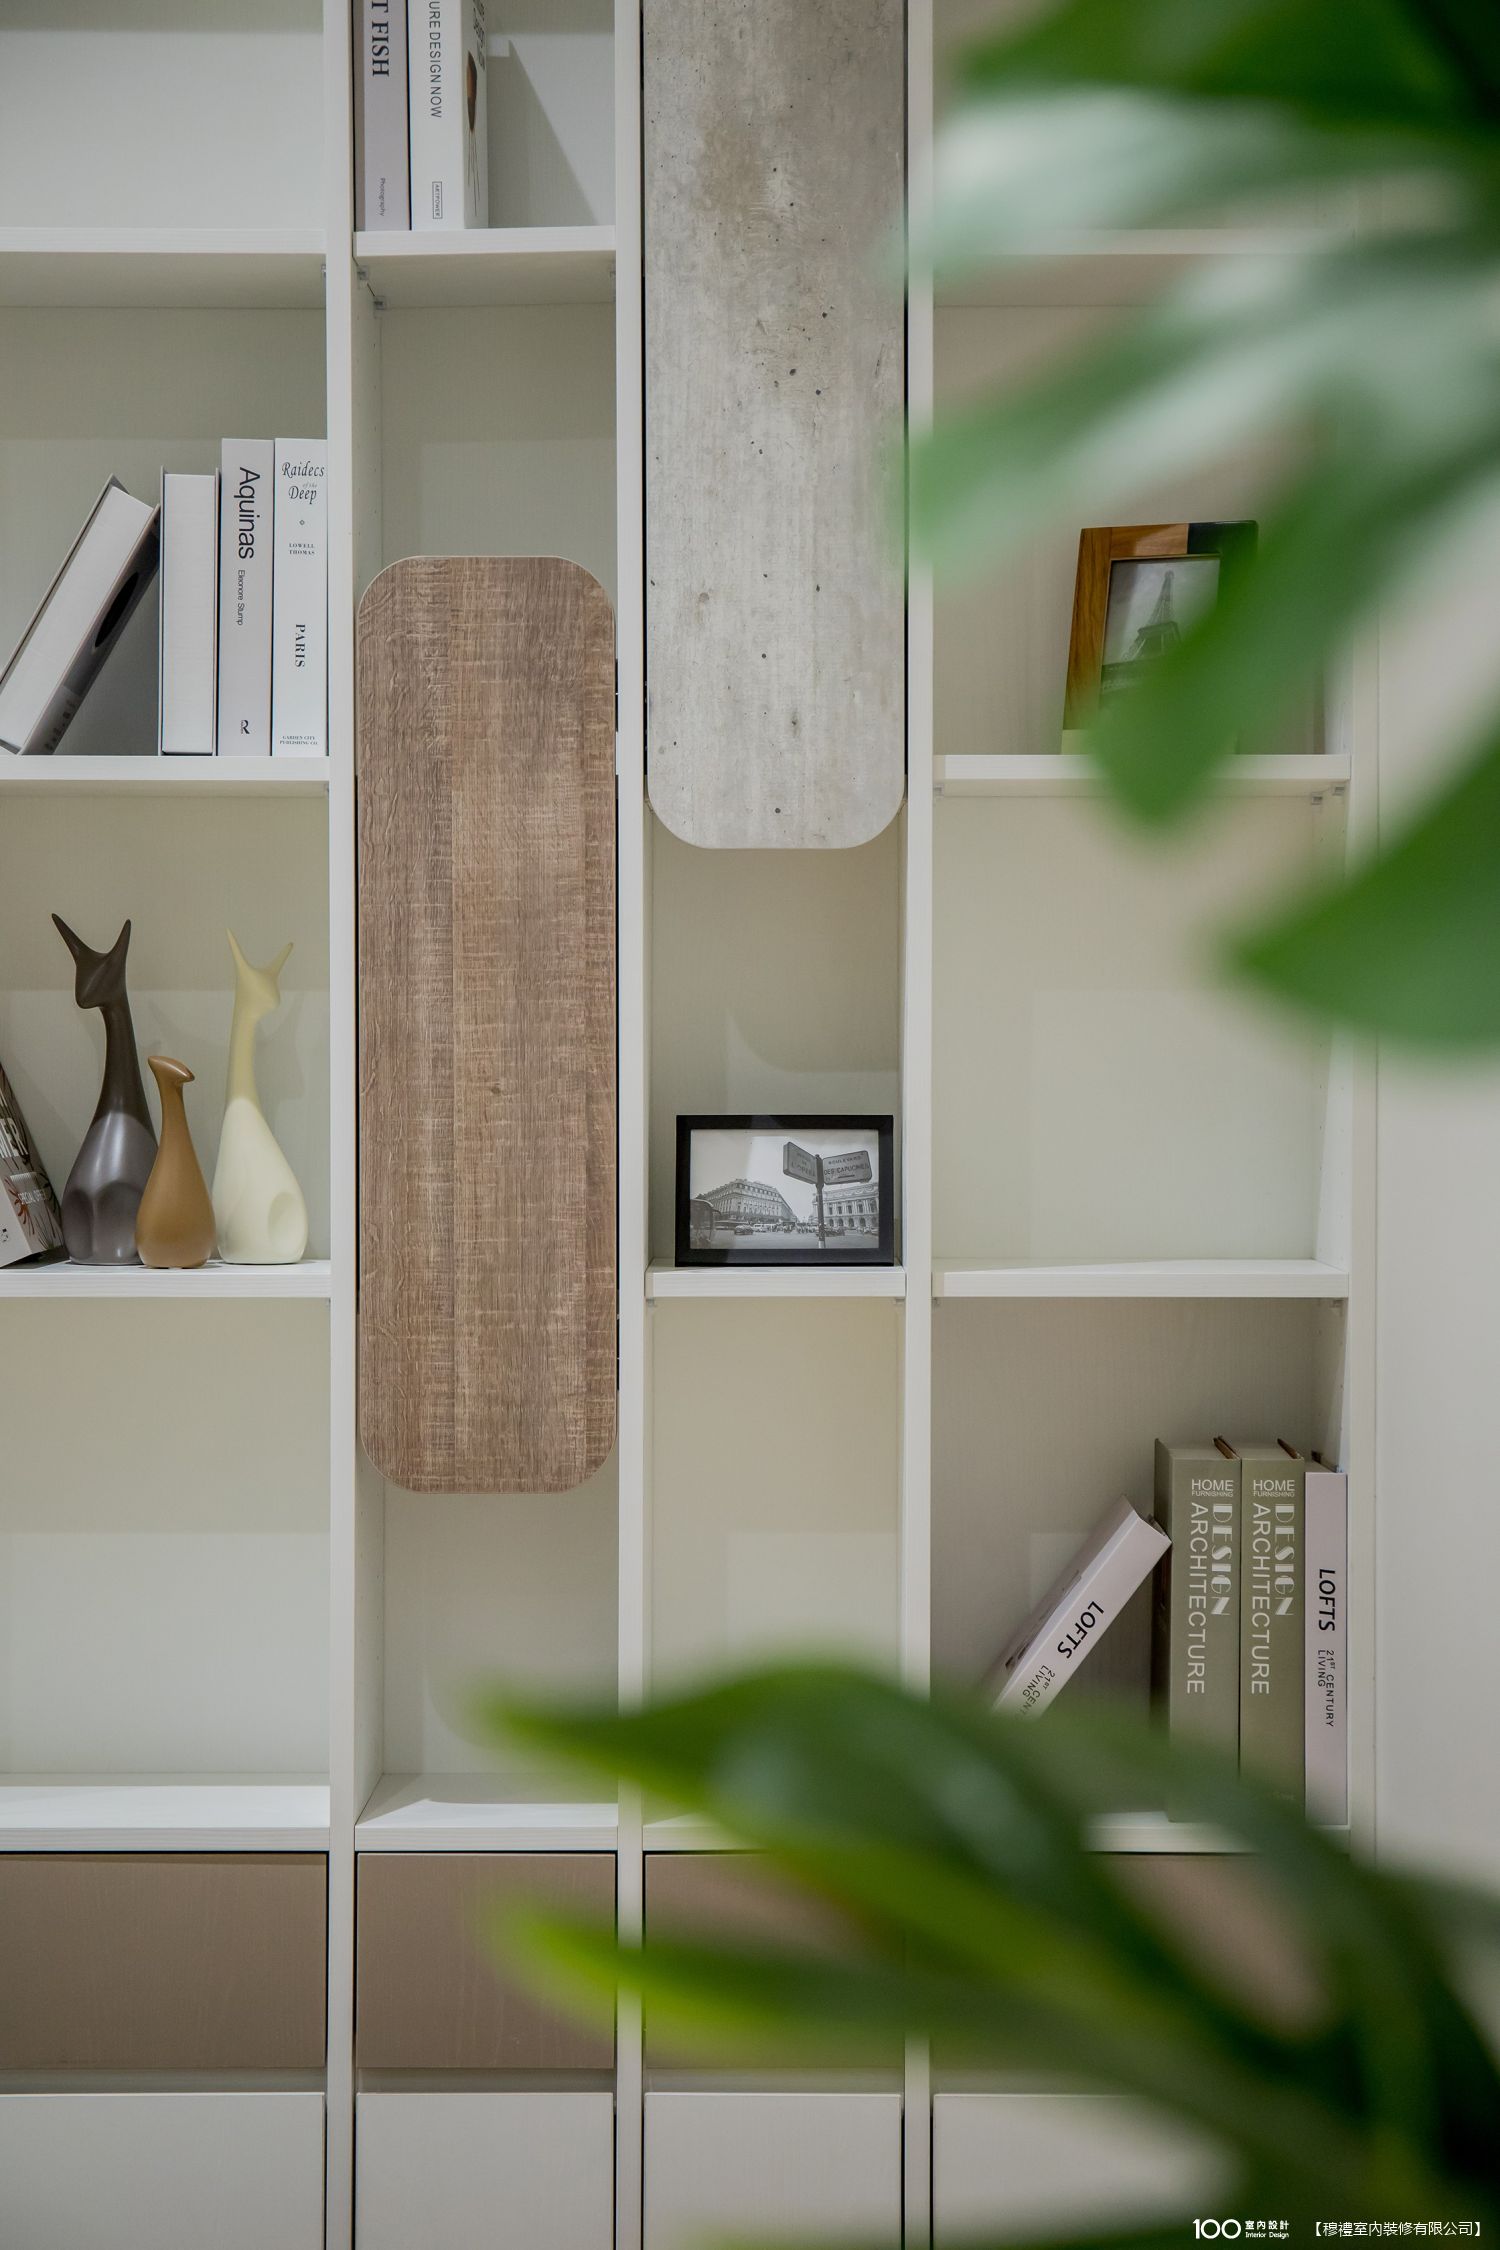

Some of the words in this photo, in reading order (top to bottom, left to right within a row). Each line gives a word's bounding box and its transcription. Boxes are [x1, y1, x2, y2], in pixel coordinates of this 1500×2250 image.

[371, 21, 390, 77] FISH
[429, 32, 442, 83] DESIGN
[430, 86, 442, 118] NOW
[375, 177, 386, 217] Photography
[233, 466, 261, 560] Aquinas
[288, 485, 317, 505] Deep
[237, 569, 246, 601] Eleonore
[236, 602, 246, 626] Stump
[295, 624, 306, 668] PARIS
[1191, 1478, 1234, 1492] HOME
[1252, 1479, 1296, 1492] HOME
[1211, 1503, 1233, 1616] DESIGN
[1274, 1503, 1295, 1616] DESIGN
[1186, 1502, 1209, 1694] ARCHITECTURE
[1251, 1502, 1272, 1695] ARCHITECTURE
[1318, 1568, 1336, 1632] LOFTS
[1057, 1600, 1105, 1660] LOFTS
[1022, 1665, 1049, 1698] LIVING
[1317, 1649, 1325, 1687] LIVING
[1325, 1674, 1335, 1727] CENTURY
